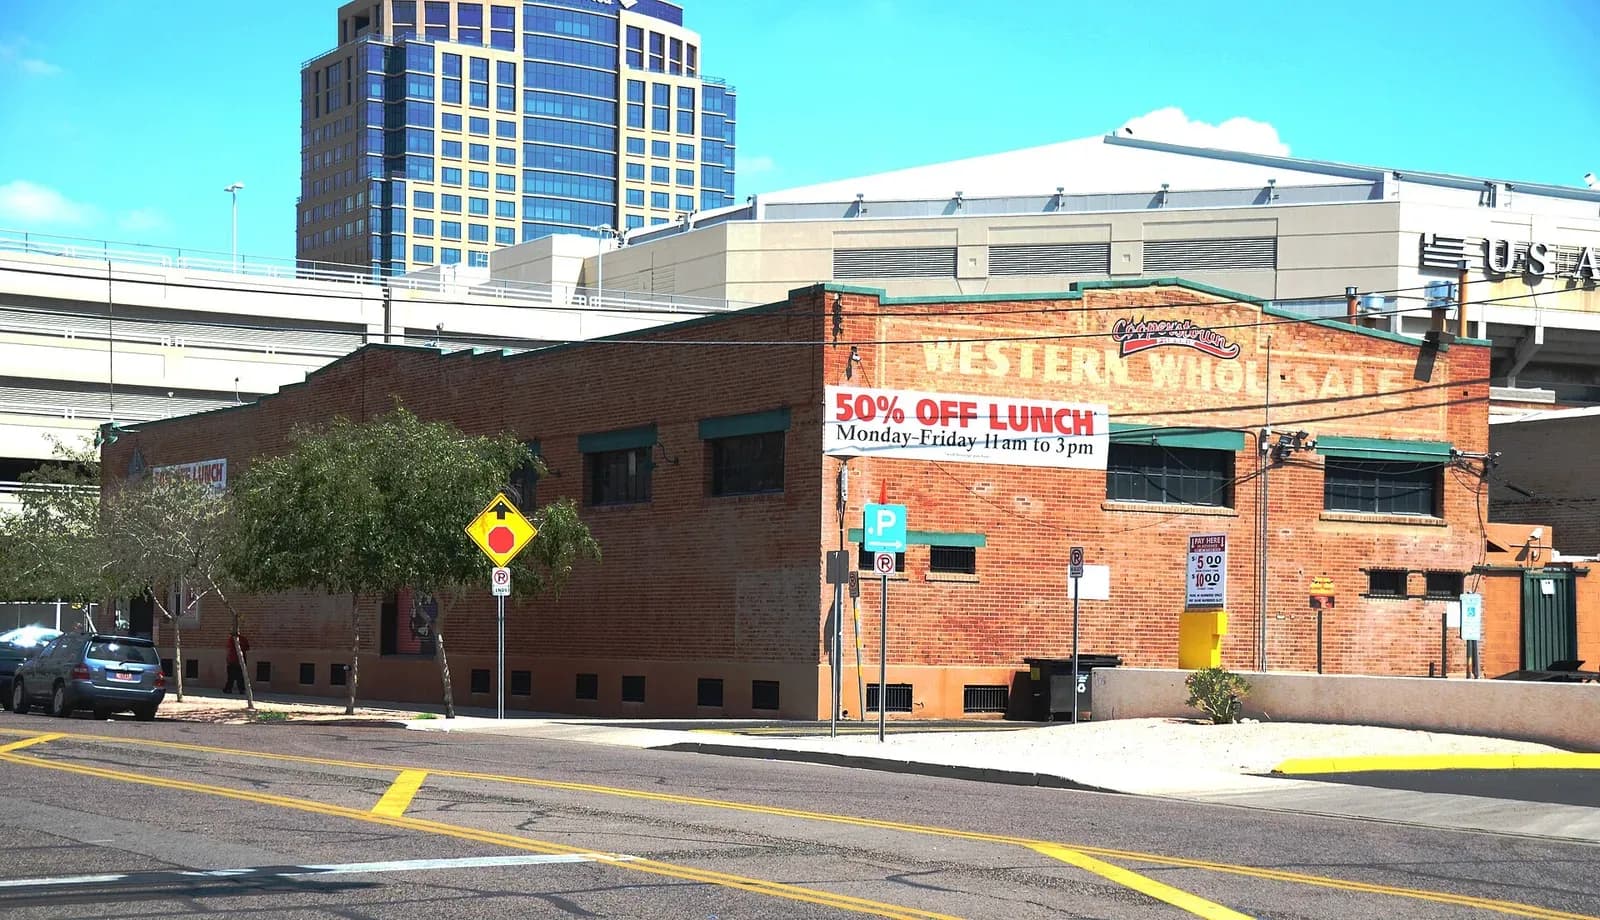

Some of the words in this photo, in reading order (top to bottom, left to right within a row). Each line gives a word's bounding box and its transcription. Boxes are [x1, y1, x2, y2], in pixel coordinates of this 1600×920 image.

[921, 335, 1130, 387] WESTERN
[1149, 352, 1405, 404] WHOLESALE
[836, 393, 905, 424] 50%
[916, 399, 978, 429] OFF
[836, 424, 977, 452] Monday-Friday
[1034, 438, 1051, 453] to
